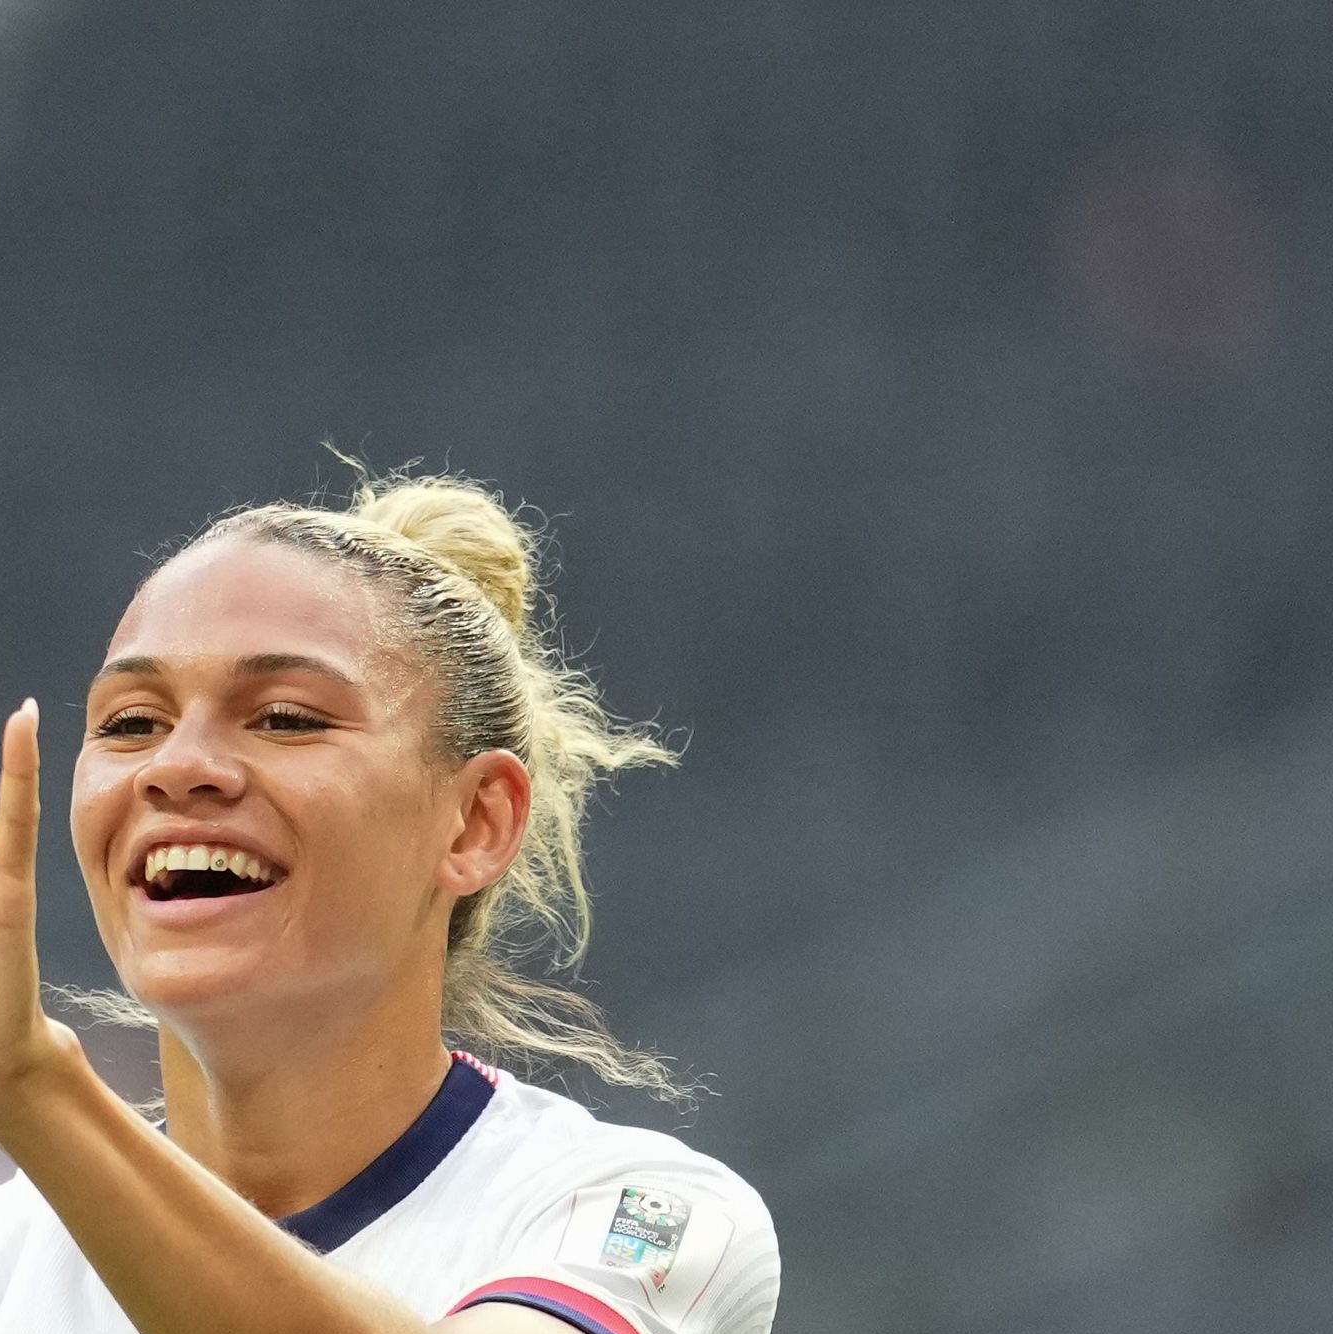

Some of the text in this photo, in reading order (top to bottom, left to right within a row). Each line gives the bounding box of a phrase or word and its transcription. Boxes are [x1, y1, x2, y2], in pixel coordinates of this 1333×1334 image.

[615, 1217, 639, 1227] FIFA
[613, 1227, 667, 1246] WORLD CUP
